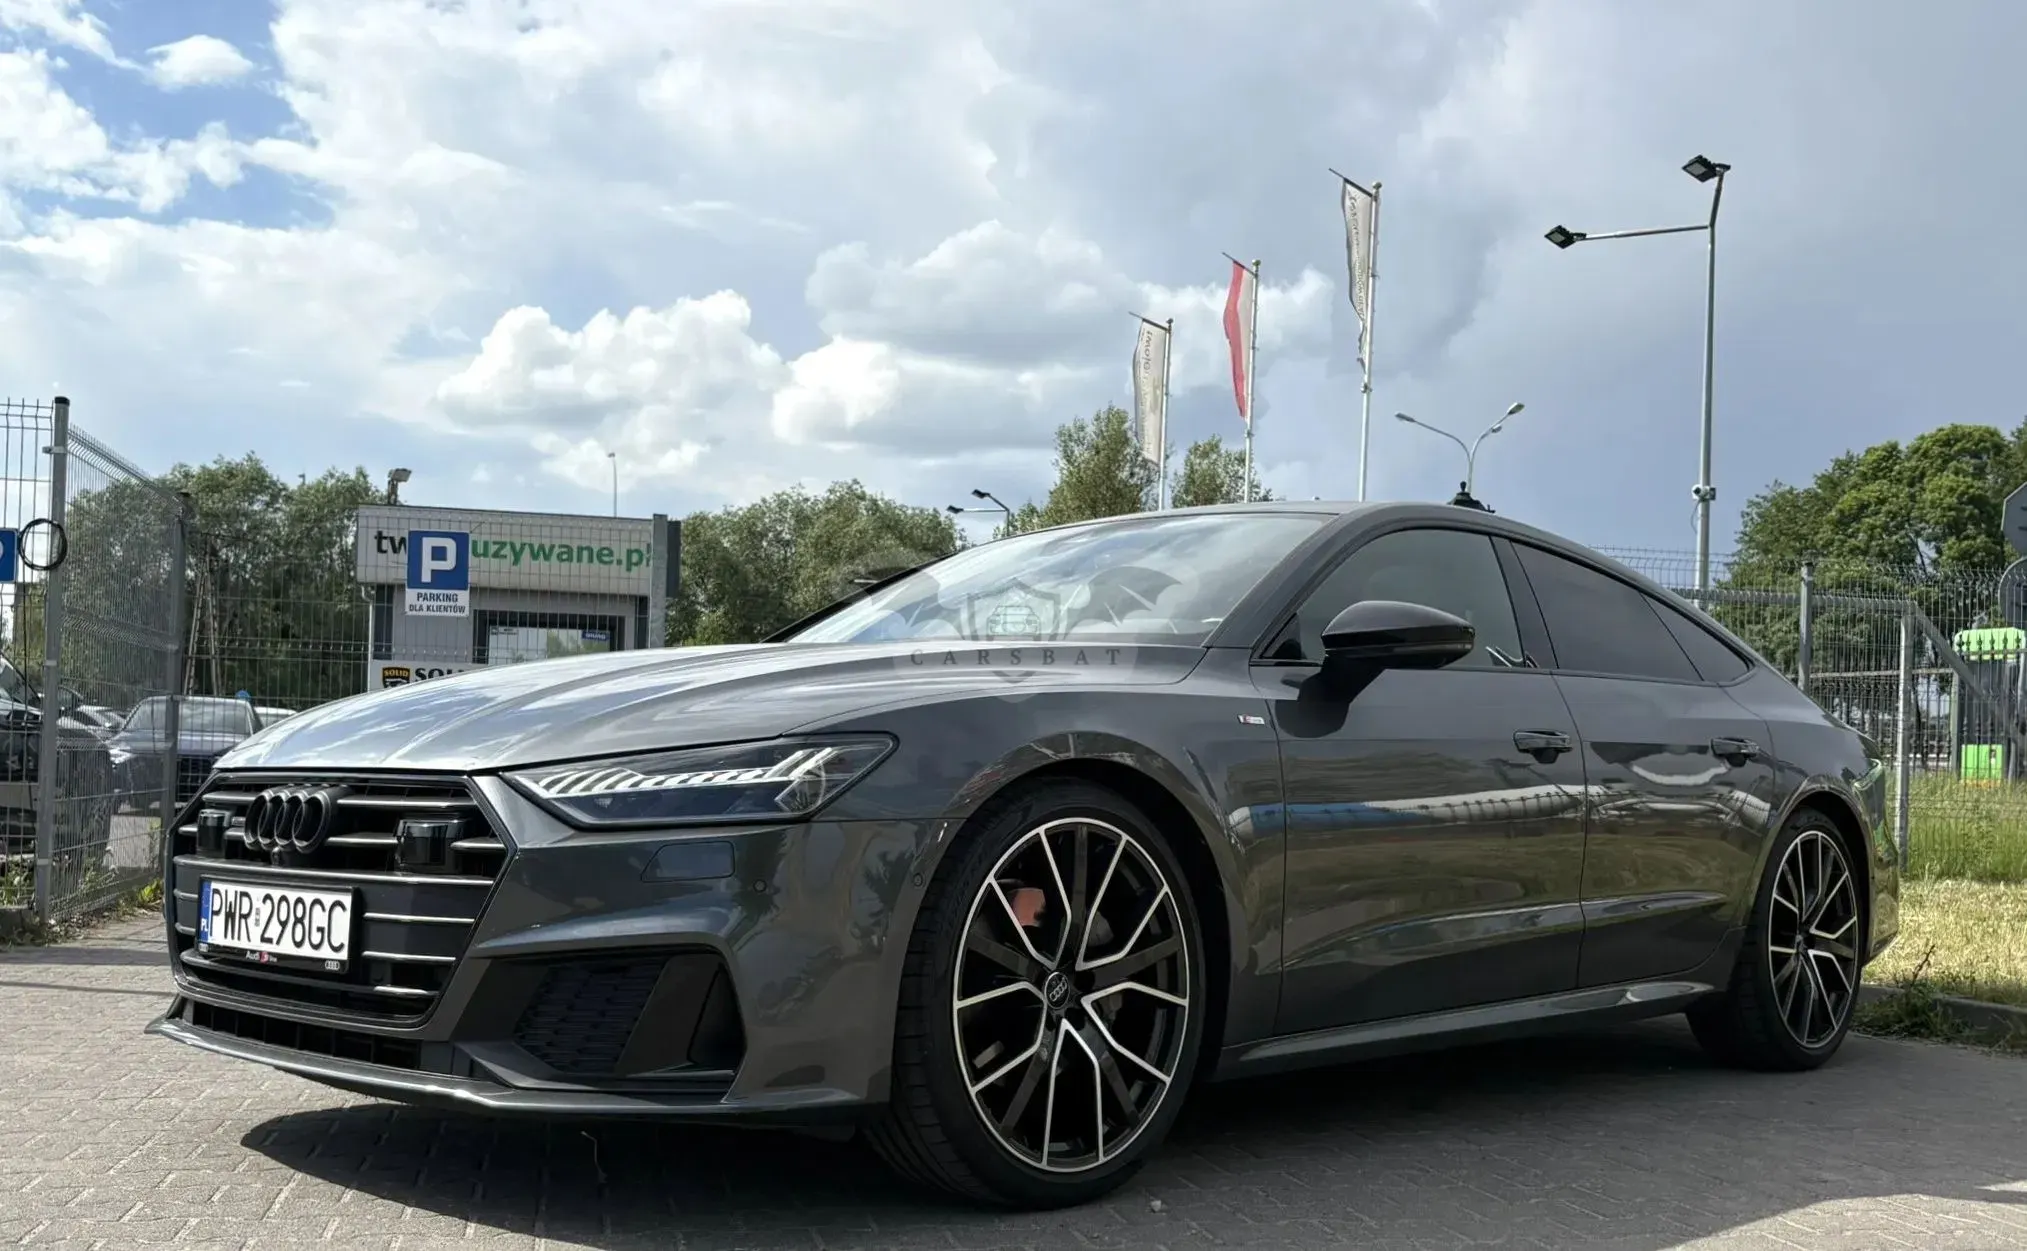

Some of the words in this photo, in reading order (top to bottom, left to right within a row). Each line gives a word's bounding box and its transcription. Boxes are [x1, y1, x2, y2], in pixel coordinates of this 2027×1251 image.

[374, 530, 407, 555] tw
[421, 536, 457, 583] P
[416, 592, 459, 603] PARKING
[409, 604, 424, 612] DLA
[426, 604, 466, 614] KLIENTÓW
[383, 668, 409, 678] SOLID
[200, 918, 209, 932] PL
[209, 887, 253, 943] PWR
[259, 892, 348, 954] 298GC
